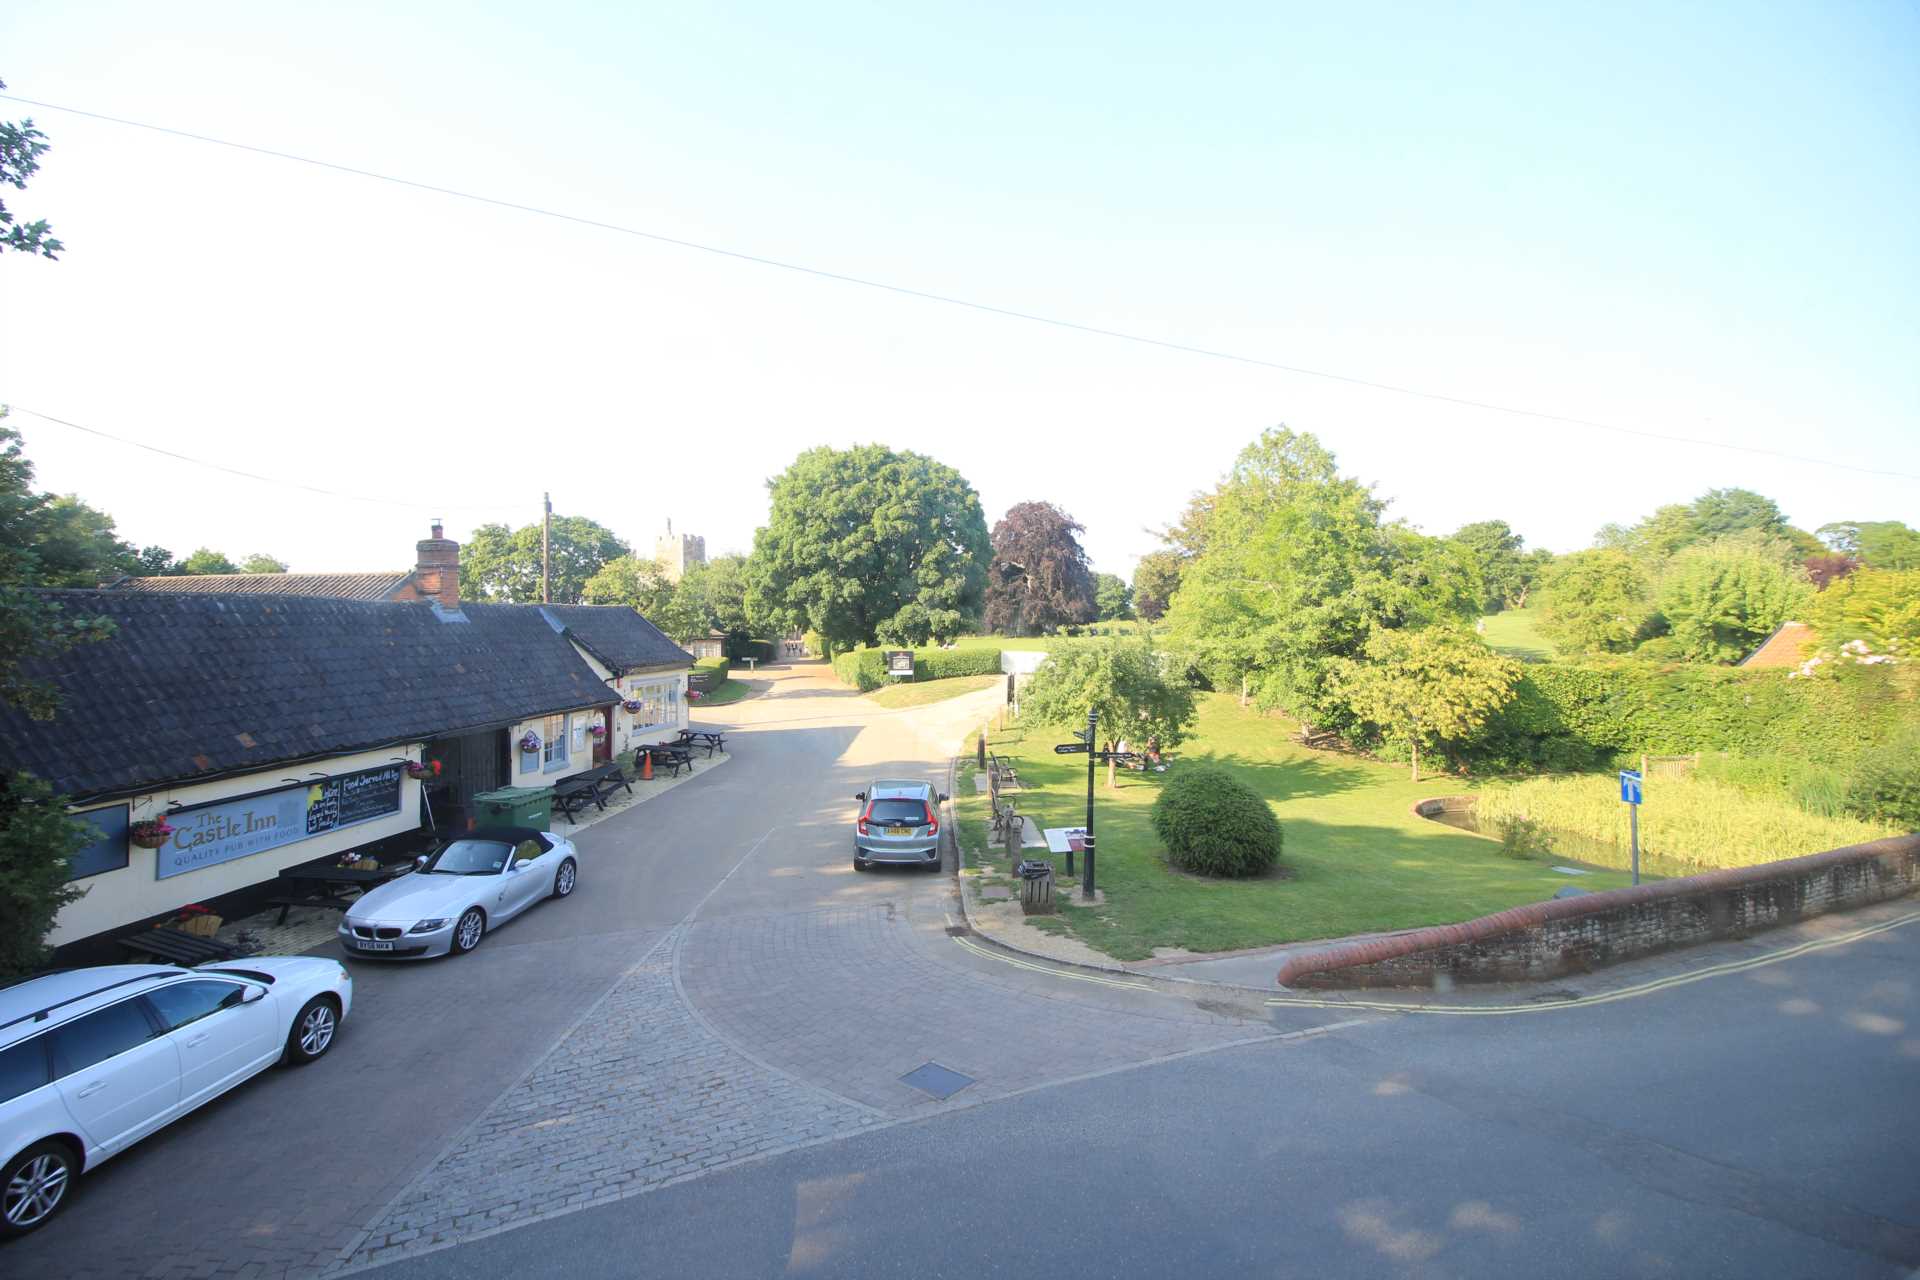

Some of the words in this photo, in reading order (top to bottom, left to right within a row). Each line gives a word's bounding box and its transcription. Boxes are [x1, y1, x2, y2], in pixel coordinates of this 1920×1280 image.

[174, 816, 241, 852] Castle
[242, 810, 277, 833] Inn
[196, 812, 222, 828] The
[175, 848, 220, 866] QUALITY
[225, 842, 244, 855] PUB
[247, 834, 271, 847] WITH
[275, 826, 299, 841] FOOD
